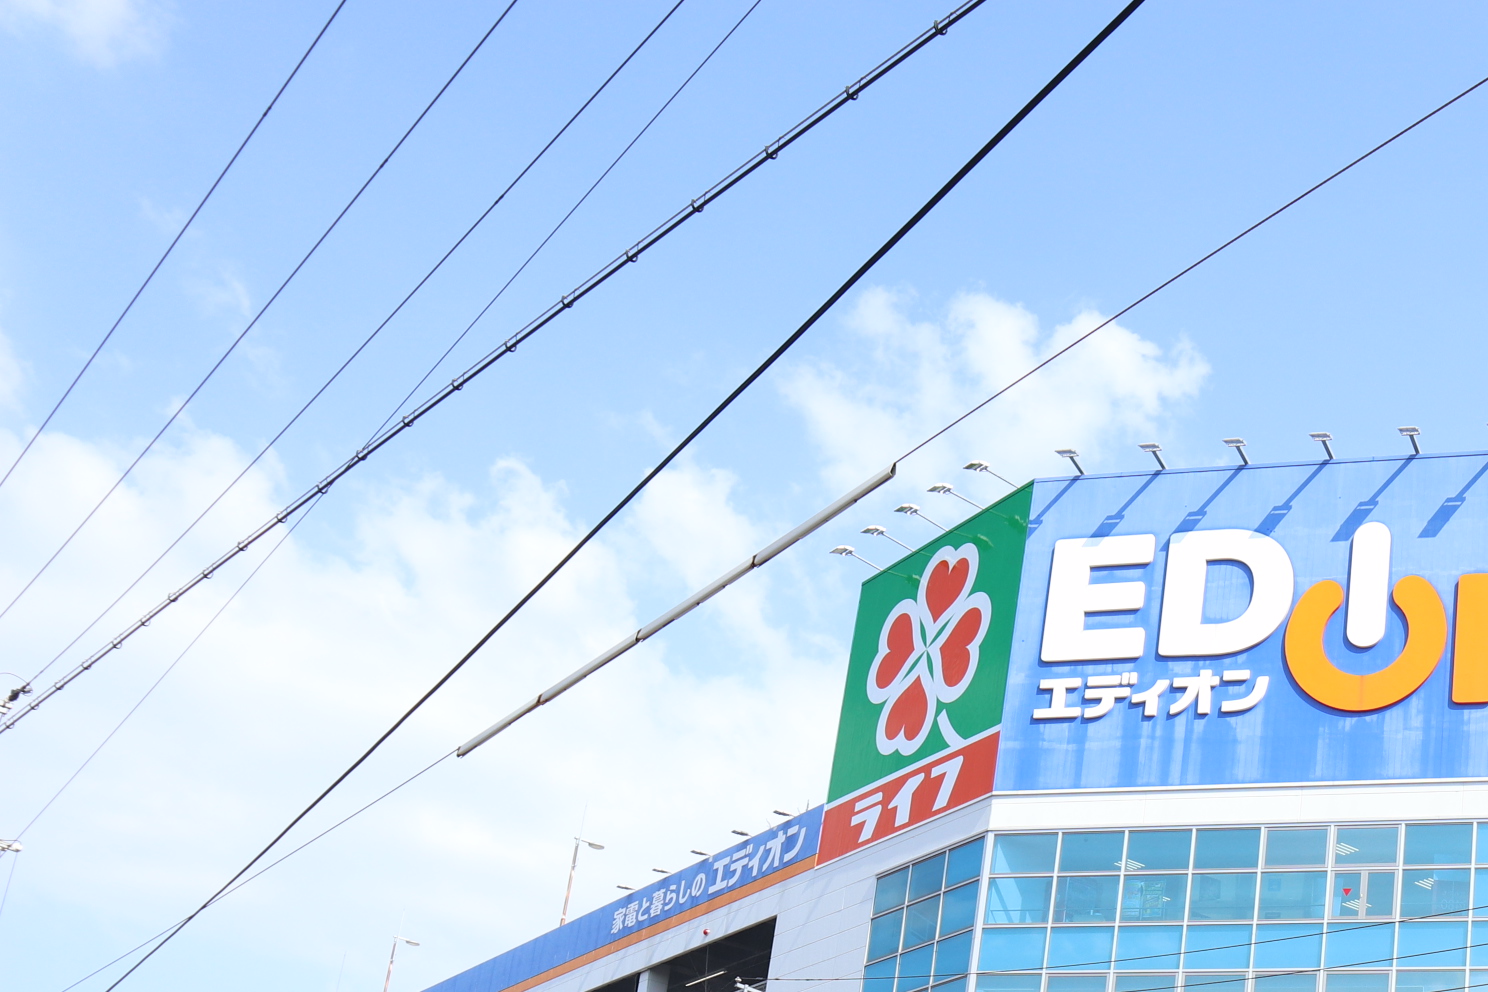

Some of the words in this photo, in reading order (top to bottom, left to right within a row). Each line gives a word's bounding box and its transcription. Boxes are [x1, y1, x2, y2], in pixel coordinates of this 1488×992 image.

[1032, 668, 1269, 721] エディオン
[849, 754, 965, 844] ライフ
